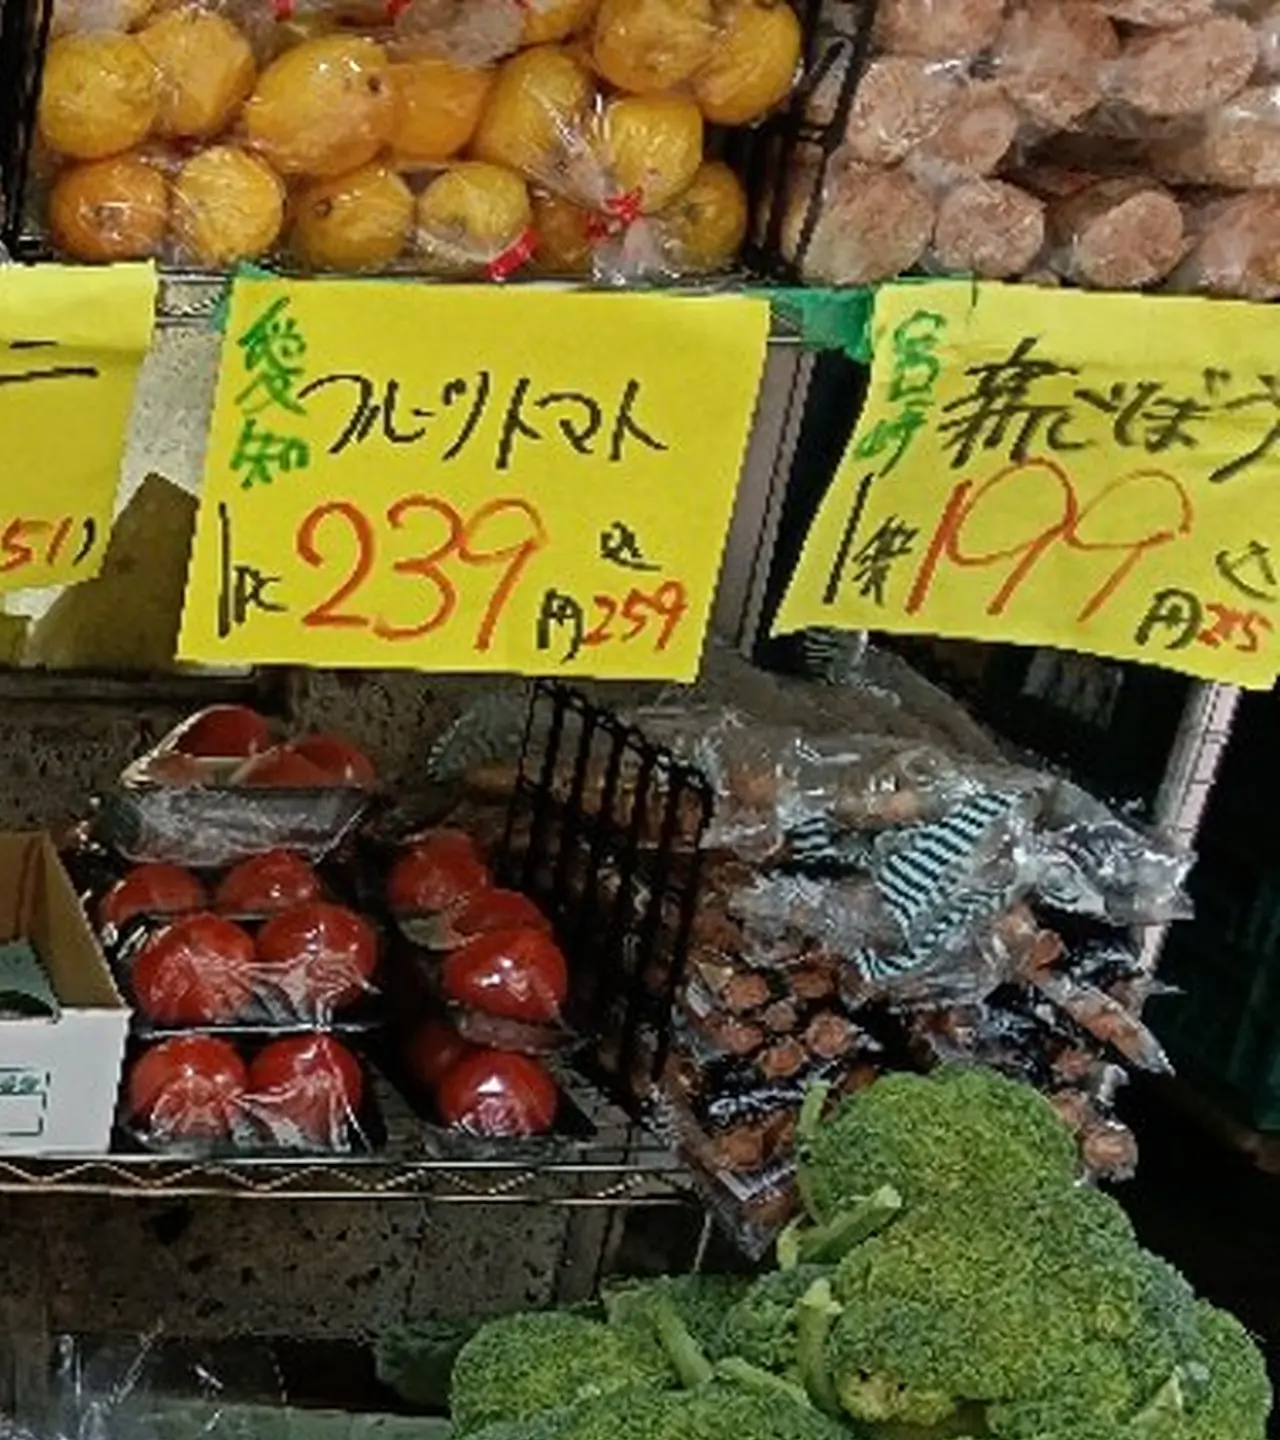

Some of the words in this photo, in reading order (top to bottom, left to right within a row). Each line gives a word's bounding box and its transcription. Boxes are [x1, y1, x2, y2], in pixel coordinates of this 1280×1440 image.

[296, 371, 670, 469] フルーツトマト
